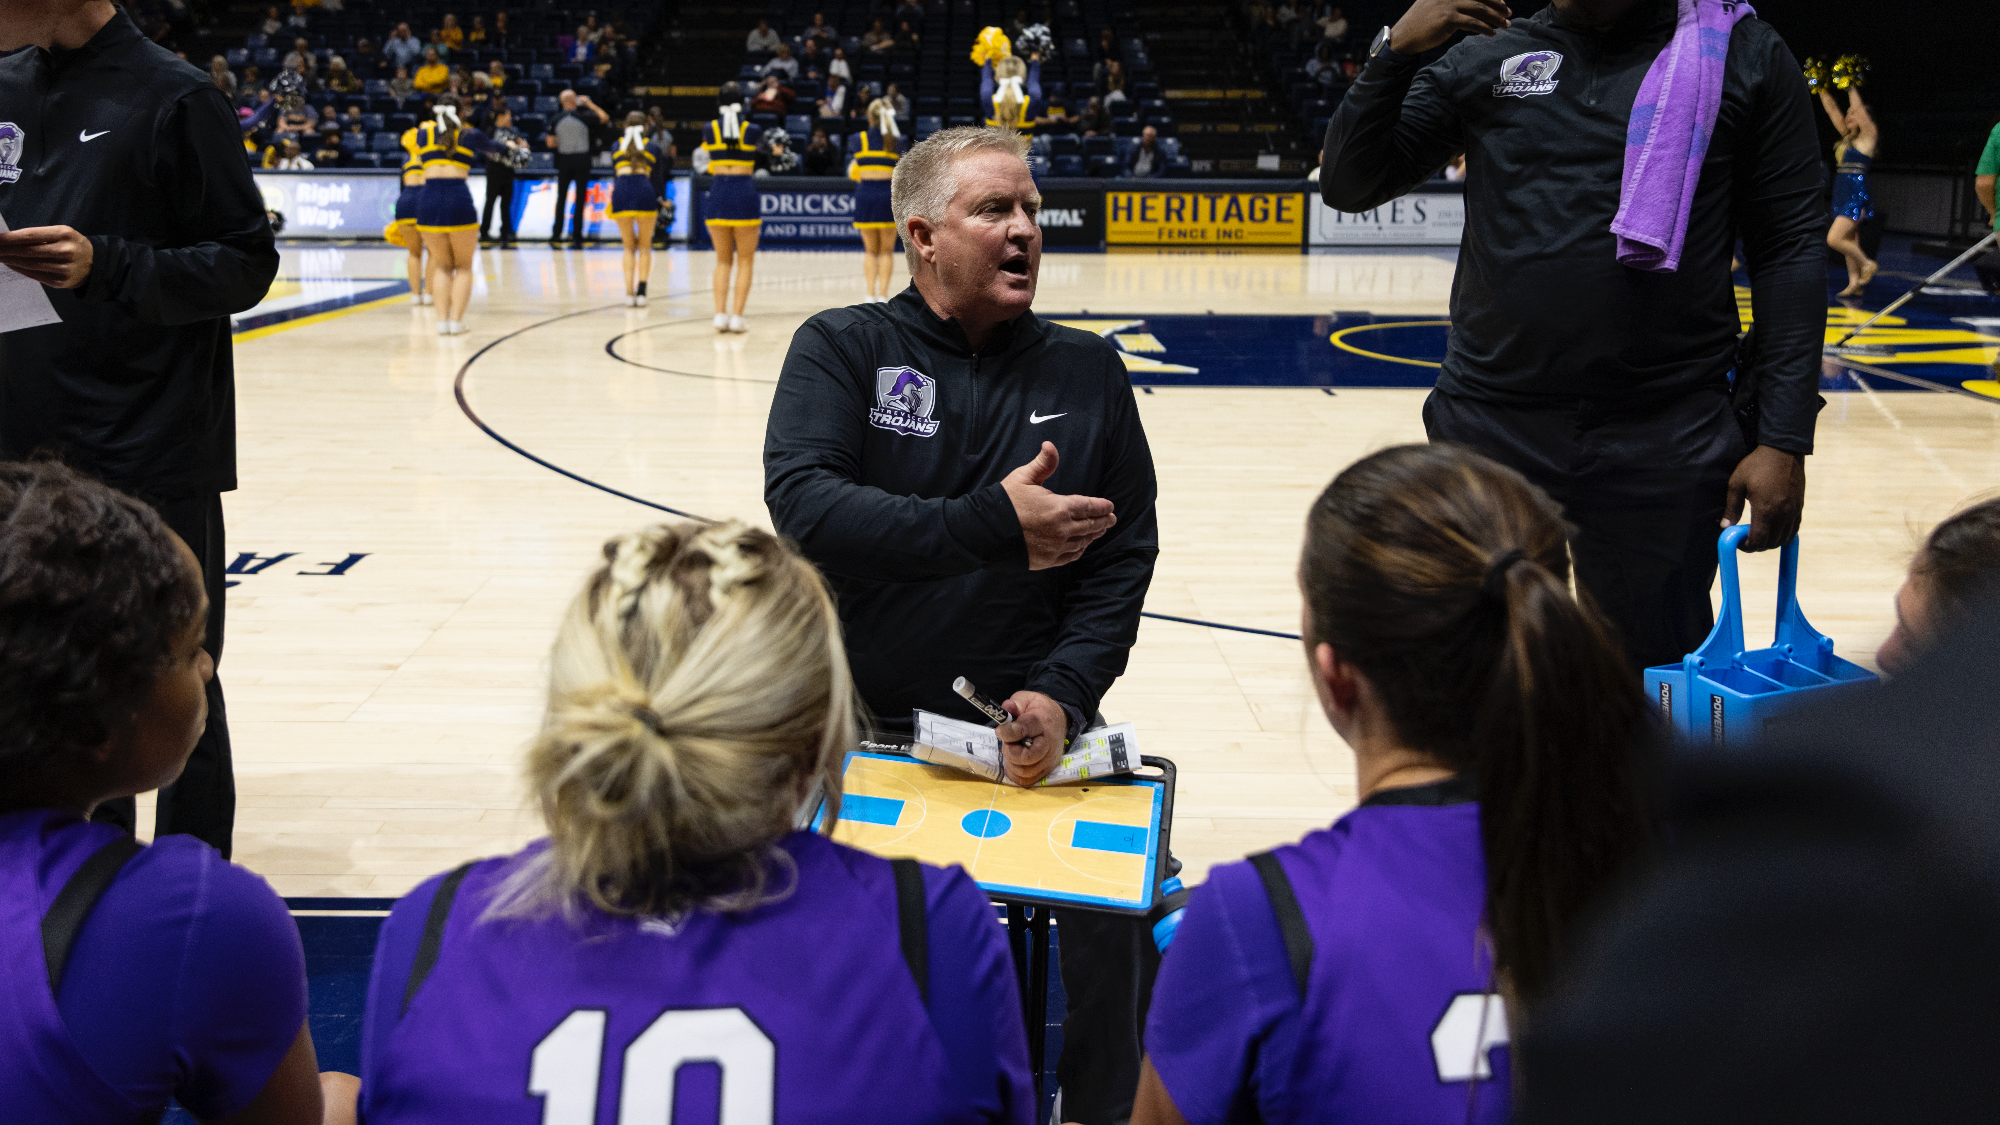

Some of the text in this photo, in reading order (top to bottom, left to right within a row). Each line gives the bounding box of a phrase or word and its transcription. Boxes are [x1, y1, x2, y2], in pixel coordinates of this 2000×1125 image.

[1496, 84, 1555, 94] TROJANS
[297, 182, 351, 206] Right
[297, 205, 345, 230] Way.
[1111, 195, 1295, 223] HERITAGE
[764, 224, 798, 237] AND
[1157, 227, 1244, 240] FENCE INC
[873, 412, 937, 434] TROJANS
[880, 408, 929, 423] TREVECCA
